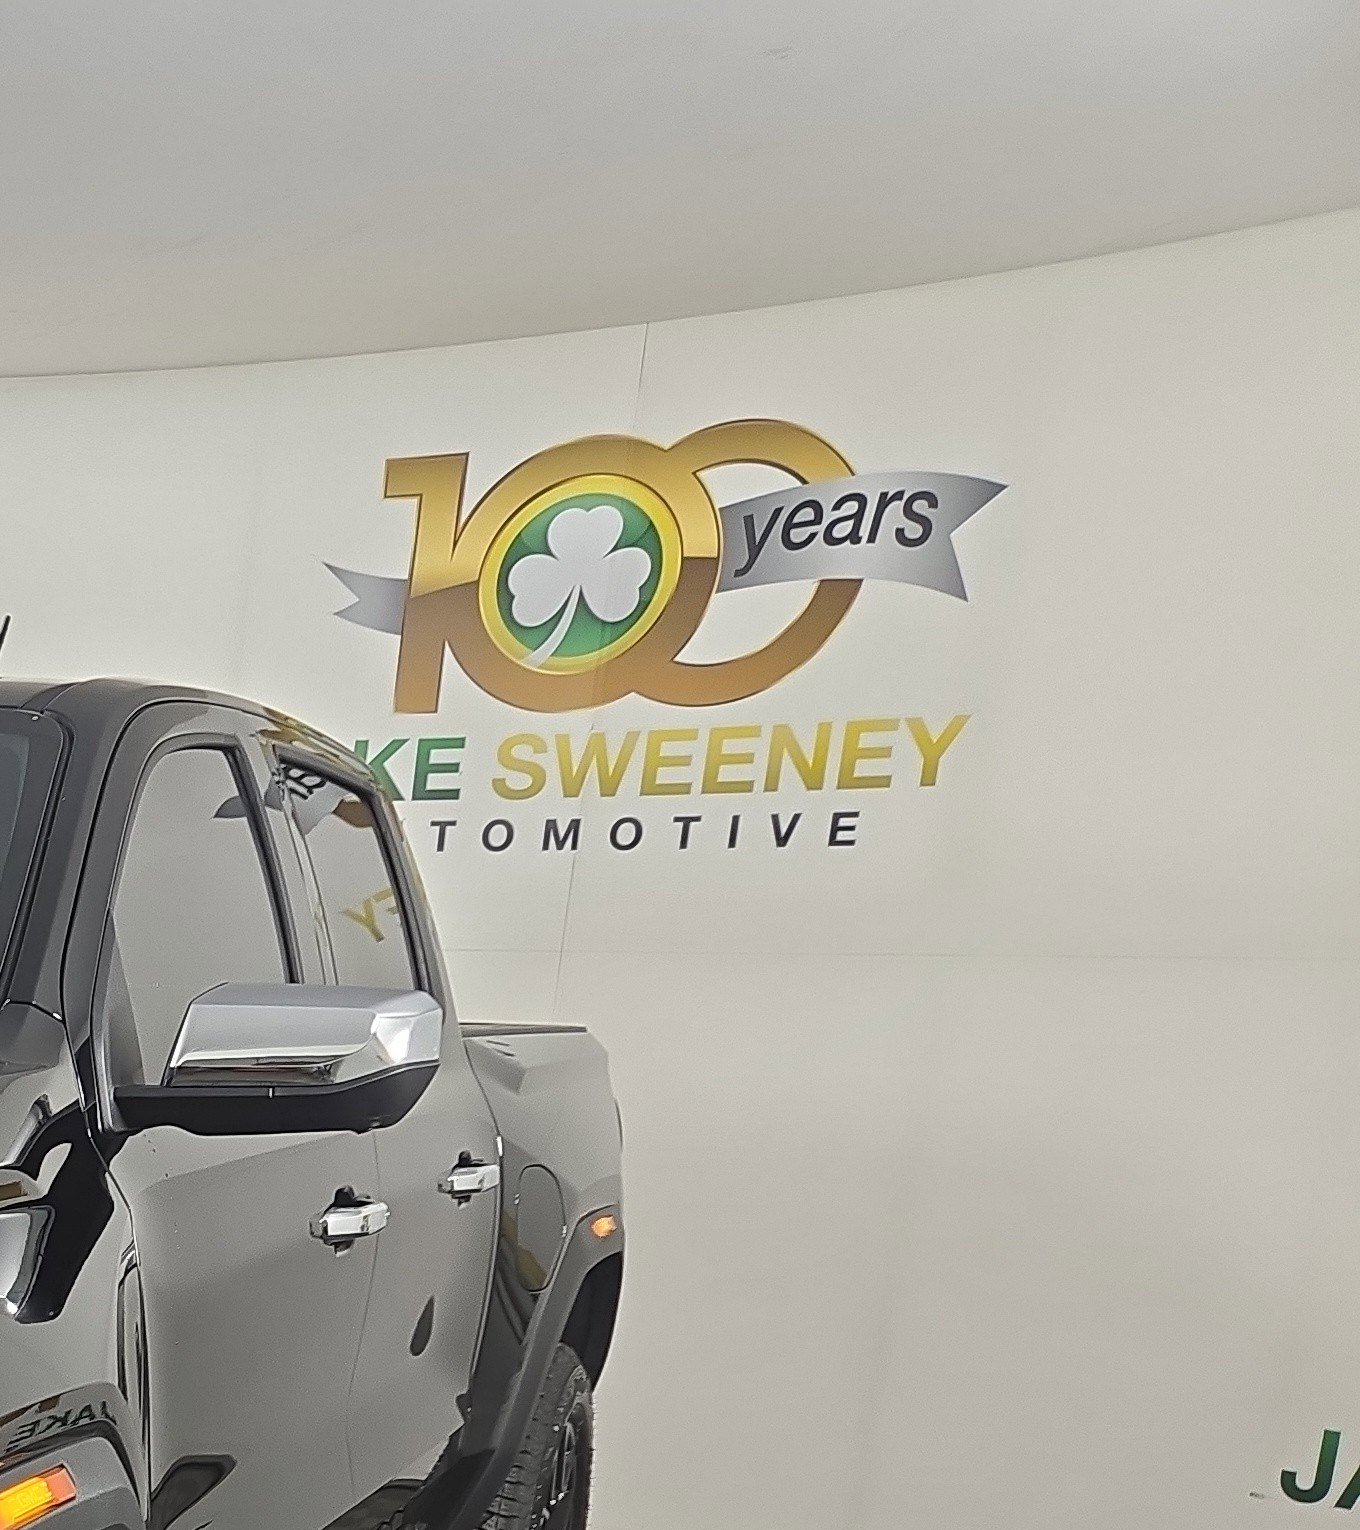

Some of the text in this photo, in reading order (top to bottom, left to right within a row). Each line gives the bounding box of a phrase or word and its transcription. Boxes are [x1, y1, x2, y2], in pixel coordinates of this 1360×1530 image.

[732, 487, 940, 578] years
[354, 735, 467, 802] KE
[491, 712, 973, 801] SWEENEY
[432, 809, 863, 854] TOMOTIVE
